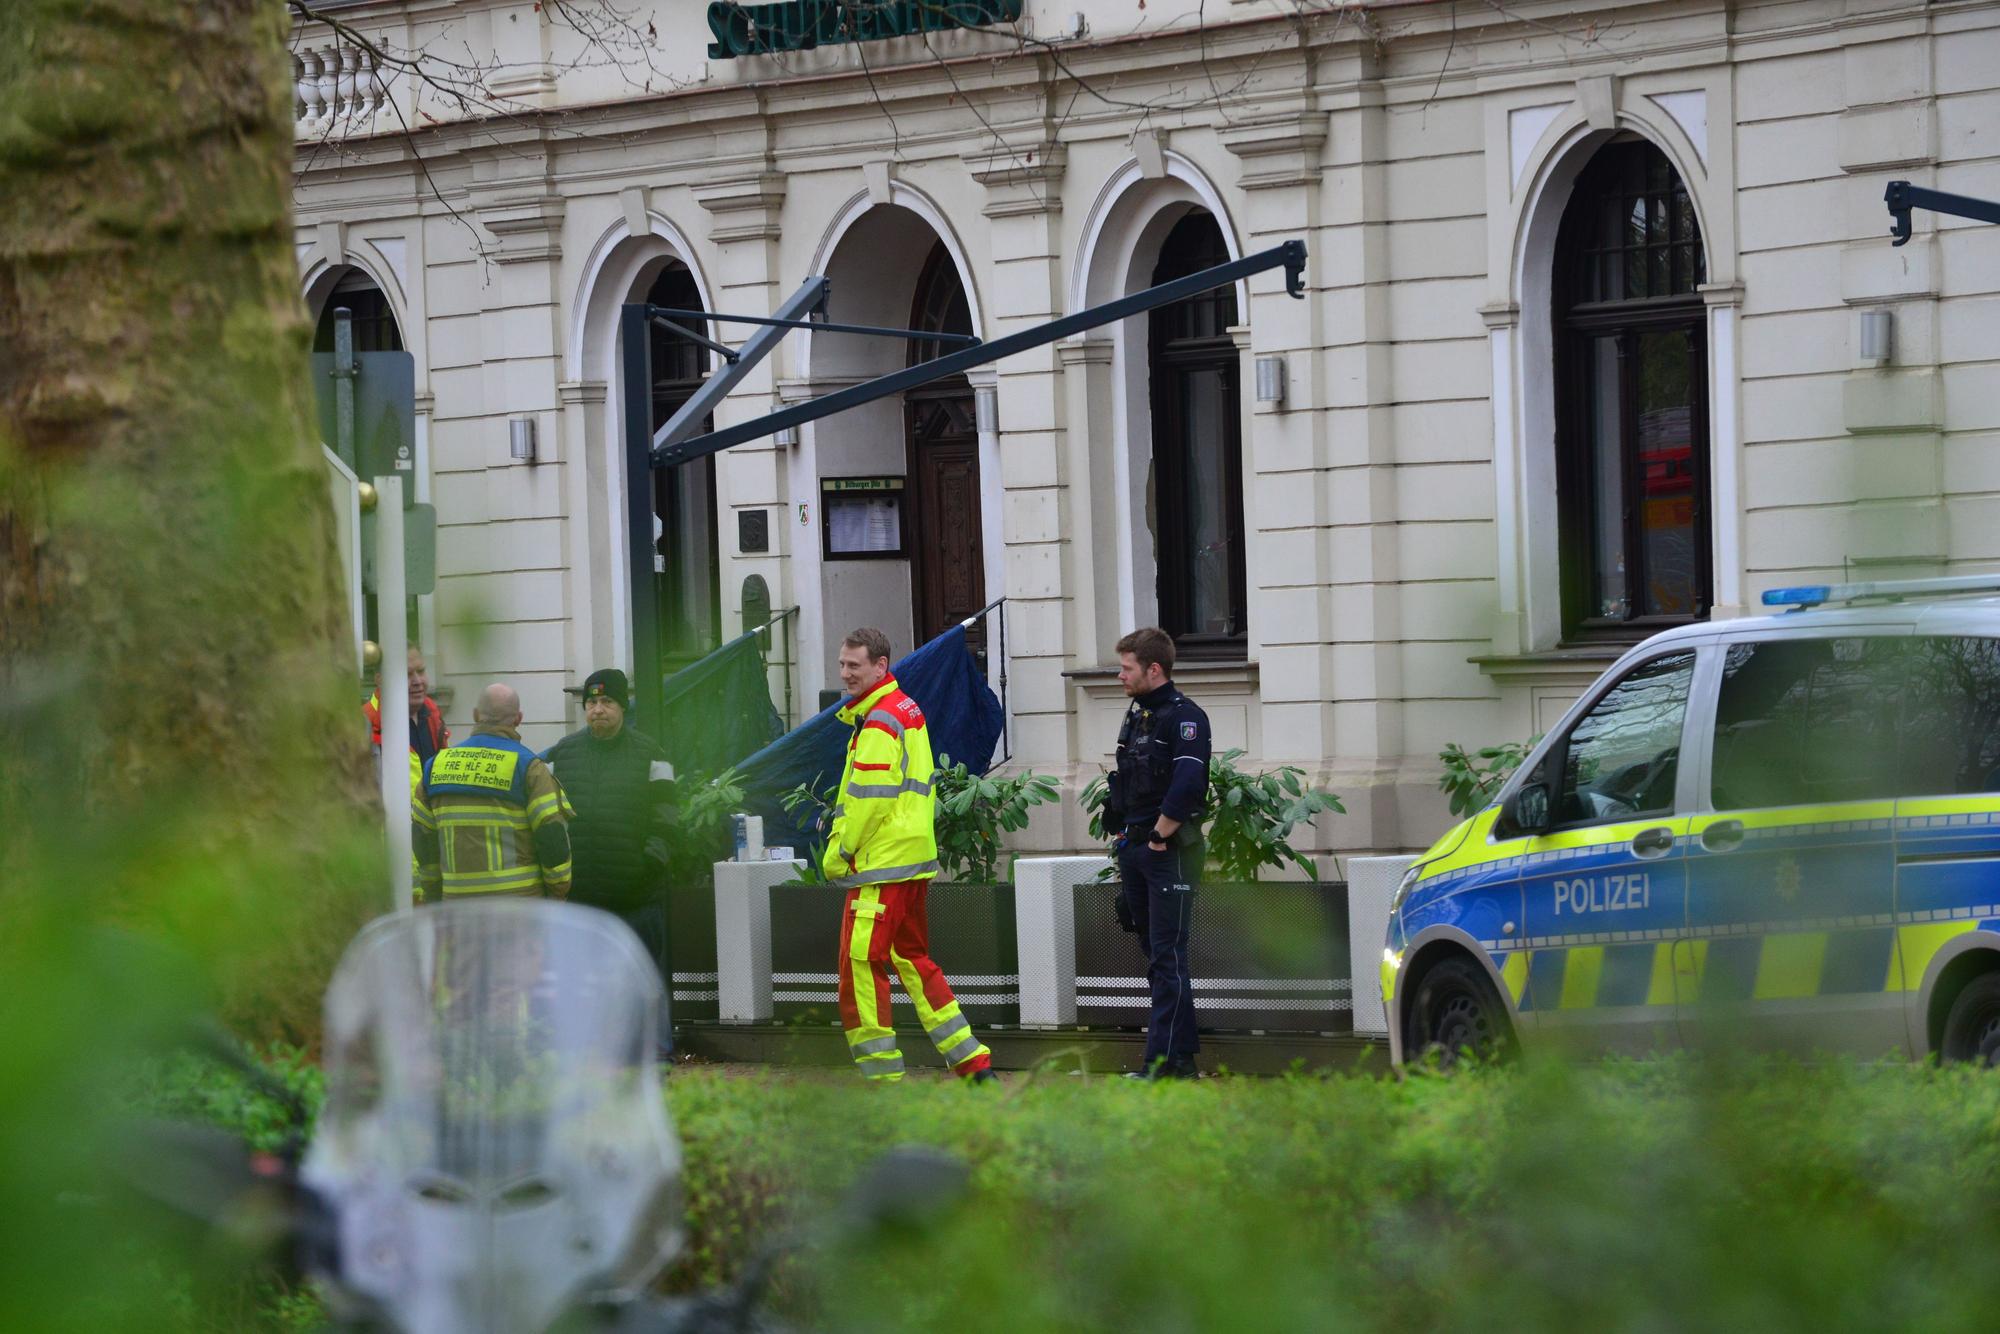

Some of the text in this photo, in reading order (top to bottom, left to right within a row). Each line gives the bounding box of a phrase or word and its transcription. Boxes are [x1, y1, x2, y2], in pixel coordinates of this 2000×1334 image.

[445, 749, 506, 761] Fahrzeugführer
[444, 761, 497, 774] FRE HLF 20
[431, 772, 510, 788] Feuerwehr Frechen
[1553, 873, 1650, 915] POLIZEI
